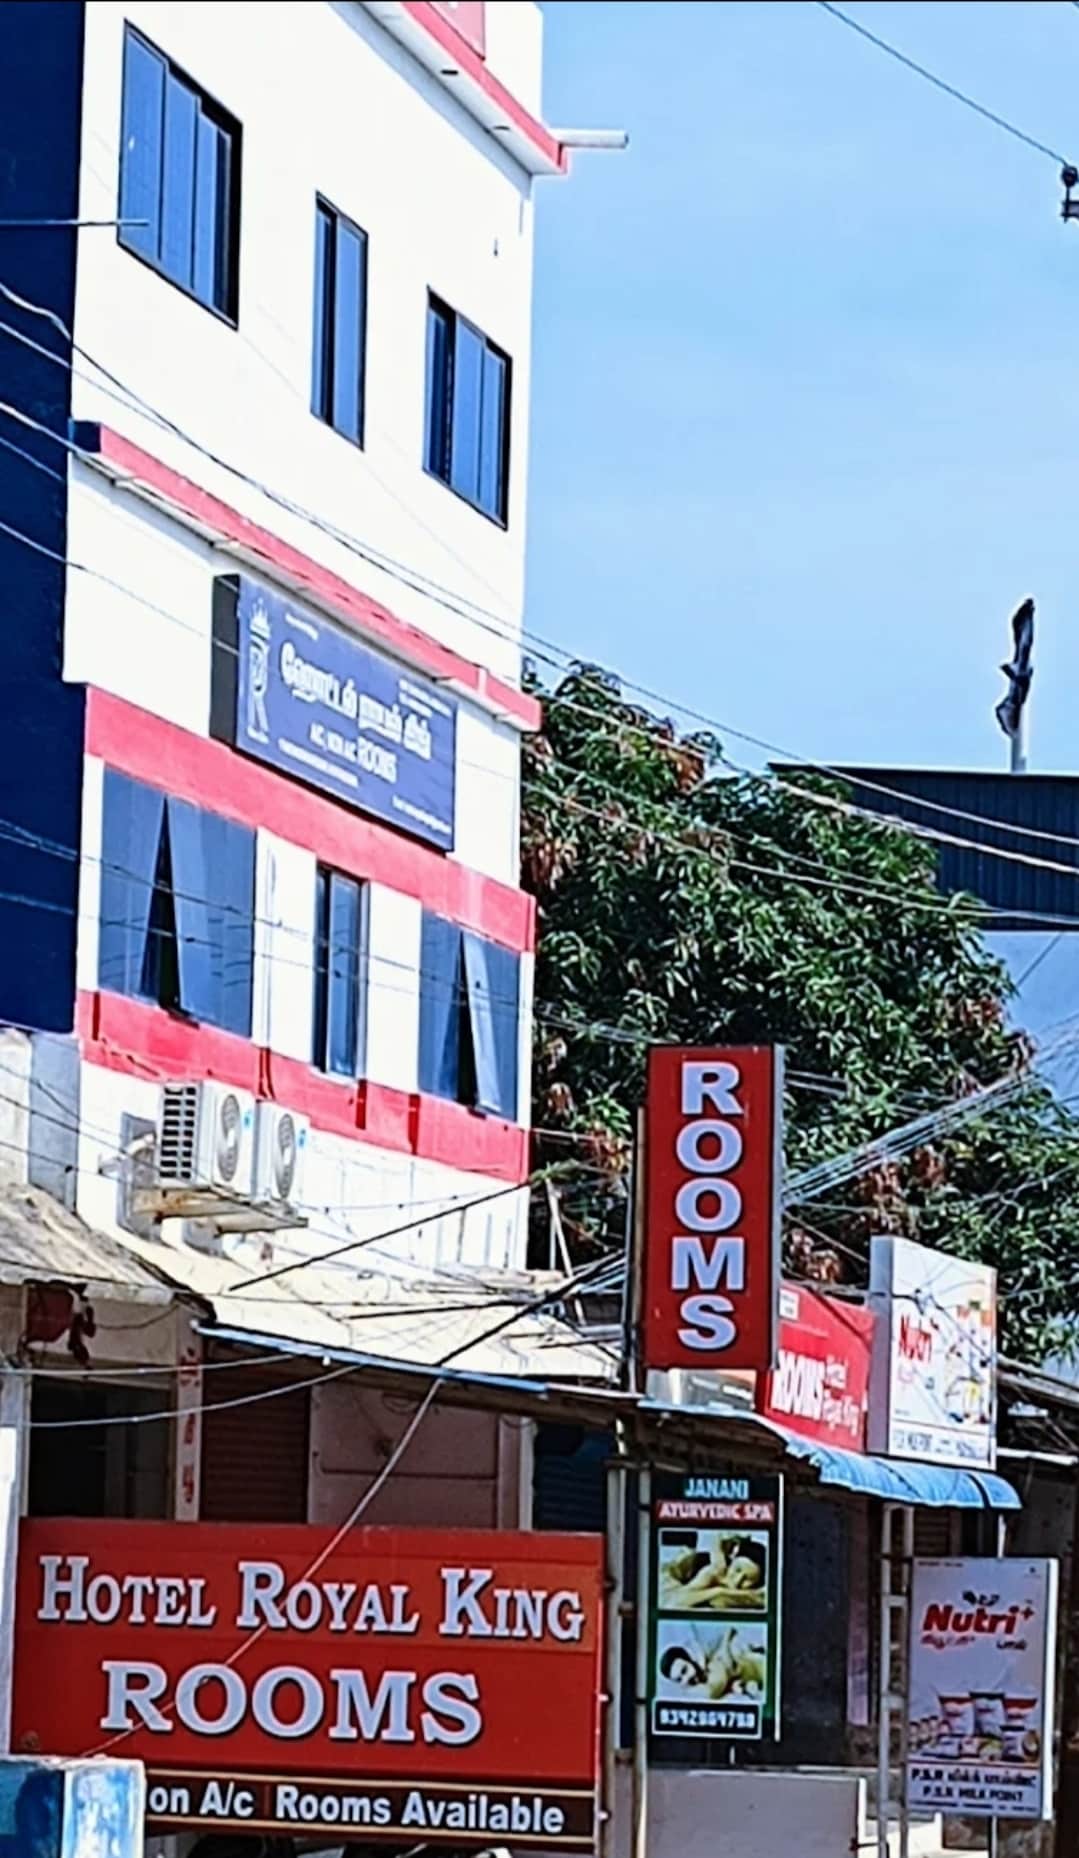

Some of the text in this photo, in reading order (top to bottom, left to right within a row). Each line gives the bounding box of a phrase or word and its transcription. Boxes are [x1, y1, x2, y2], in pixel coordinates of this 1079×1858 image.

[671, 1061, 744, 1350] ROOMS
[685, 1479, 748, 1499] JANANI
[659, 1502, 772, 1520] AYURVEDIC SPA
[100, 1660, 482, 1745] ROOMS
[200, 1781, 254, 1816] A/c
[276, 1785, 392, 1824] Rooms
[402, 1791, 564, 1833] Available
[989, 1789, 1024, 1801] POINT
